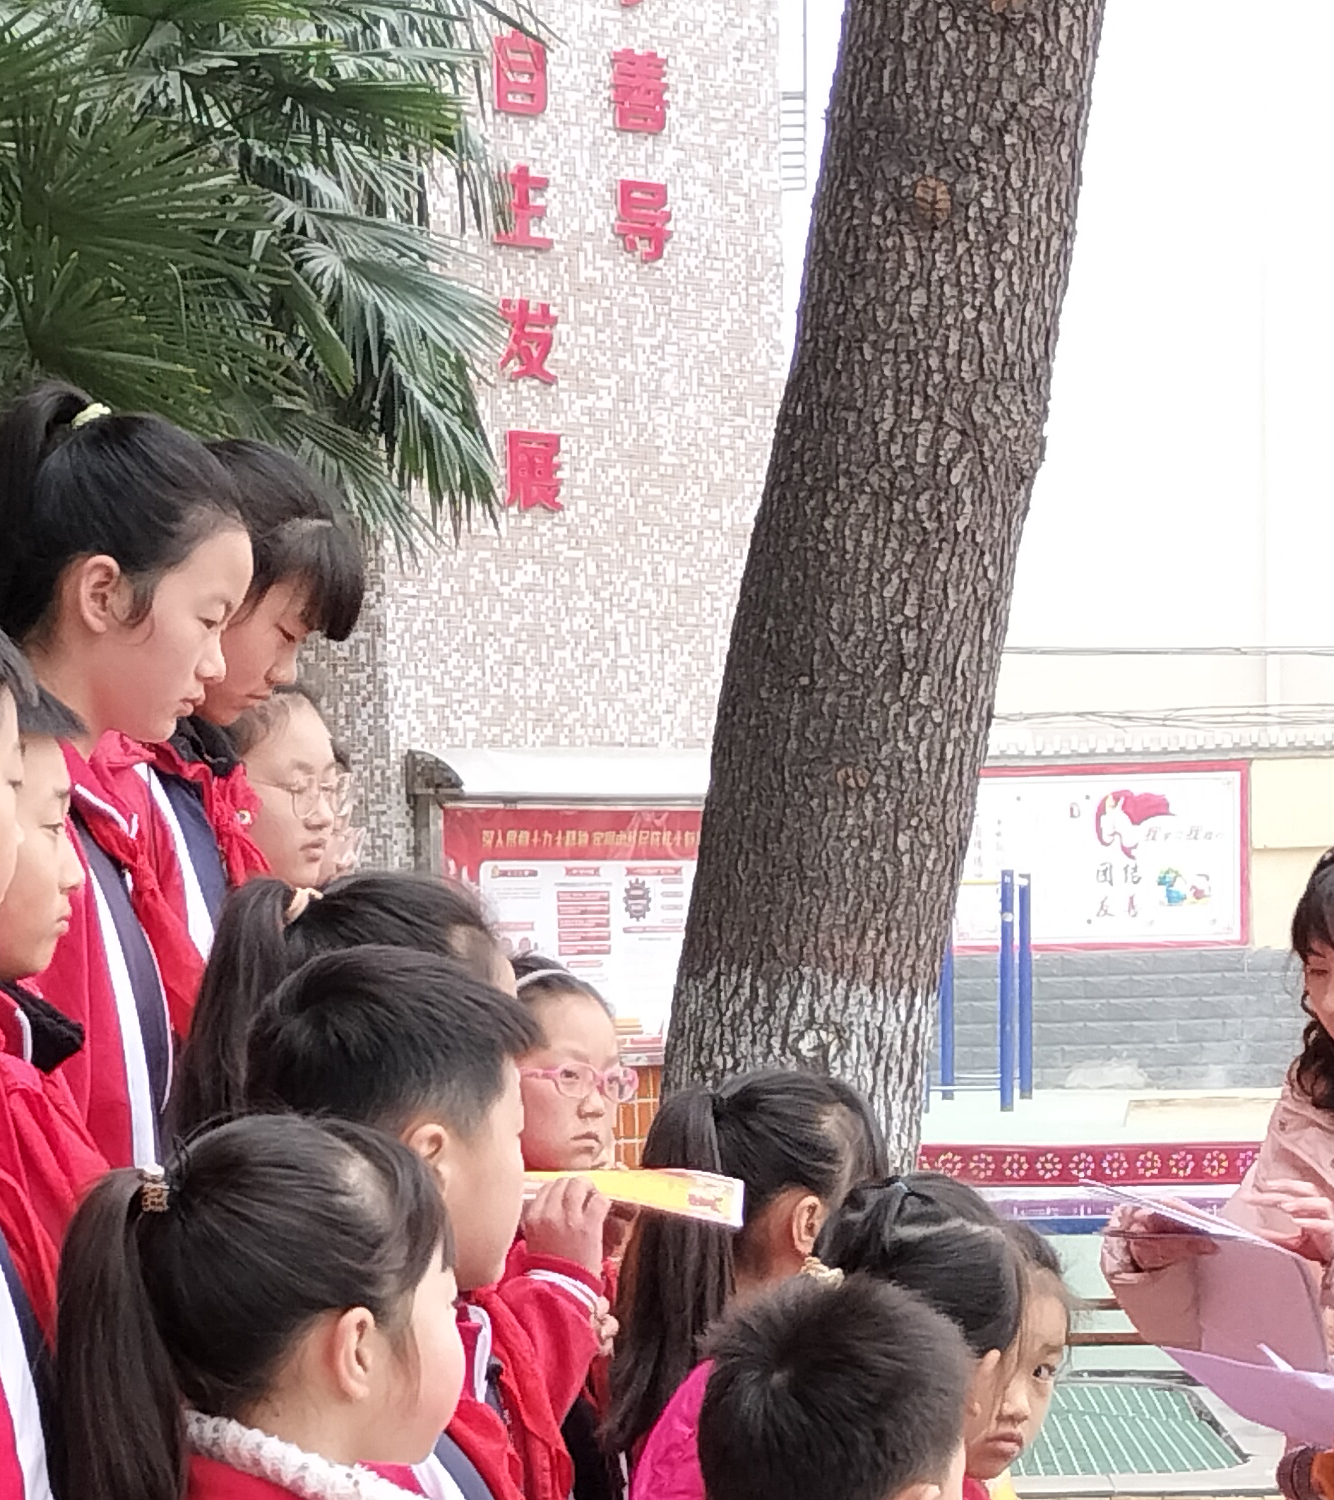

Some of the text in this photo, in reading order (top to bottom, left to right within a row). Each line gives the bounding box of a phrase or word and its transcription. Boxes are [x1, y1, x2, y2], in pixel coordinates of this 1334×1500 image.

[493, 29, 563, 512] 自主发展
[610, 0, 672, 262] 善导
